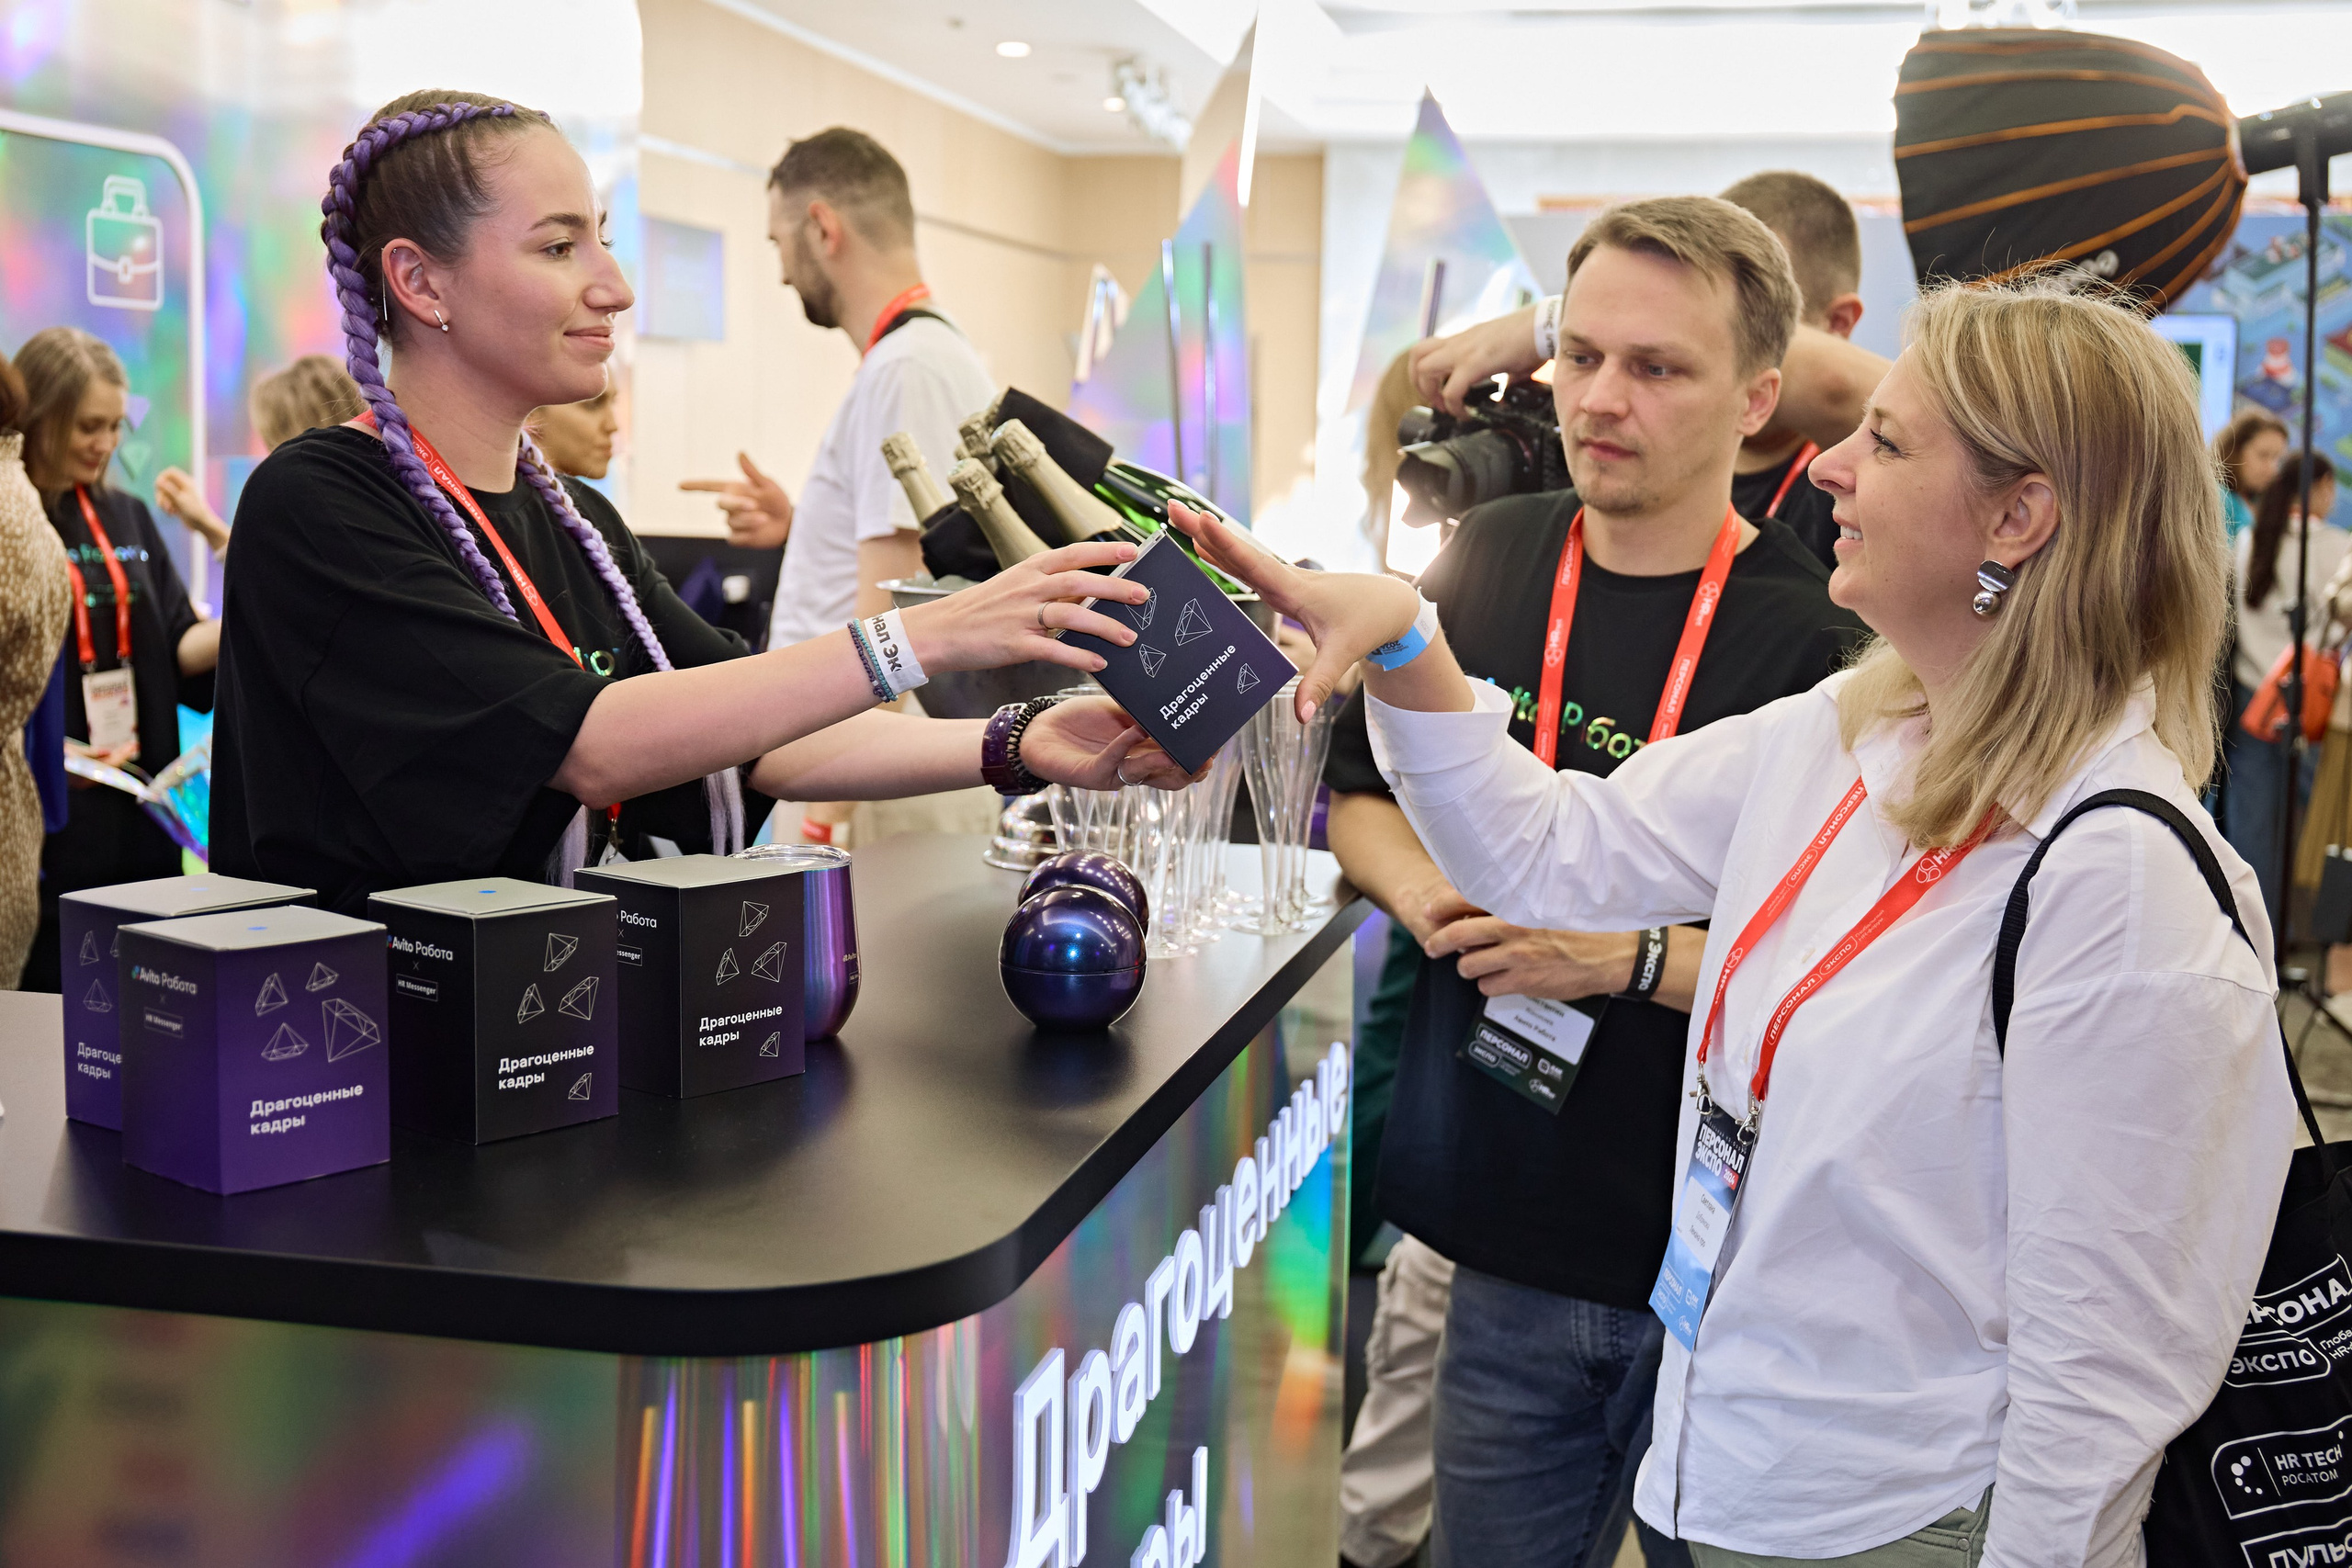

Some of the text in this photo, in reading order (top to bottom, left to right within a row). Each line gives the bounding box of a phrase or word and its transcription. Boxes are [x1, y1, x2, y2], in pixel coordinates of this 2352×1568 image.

[413, 440, 481, 521] ПЕРСОНАЛ ЭКС
[882, 643, 902, 672] Эк
[1159, 645, 1237, 720] Драгоценные
[1667, 659, 1690, 715] ПЕРСОНАЛ
[1170, 693, 1209, 729] кадры
[1791, 786, 1865, 881] ПЕРСОНАЛ ЭКСПО
[620, 909, 657, 929] Работа
[391, 936, 454, 962] Avito Работа
[616, 949, 641, 961] ssenger
[161, 972, 198, 995] Работа
[406, 980, 436, 996] Messenger
[1770, 943, 1852, 1040] ПЕРСОНАЛ ЭКСПО
[699, 1006, 783, 1032] Драгоценные
[699, 1031, 740, 1046] кадры
[1479, 1029, 1529, 1063] ПЕРСОНАЛ
[77, 1042, 122, 1065] Драгоце
[498, 1044, 594, 1074] Драгоценные
[77, 1062, 111, 1079] кадры
[498, 1072, 545, 1089] кадры
[250, 1084, 364, 1119] Драгоценные
[250, 1114, 306, 1135] кадры
[1695, 1141, 1723, 1177] ЭКСПО
[1699, 1122, 1746, 1174] ПЕРСОНАЛ
[1003, 1041, 1349, 1568] Драгоценные
[2319, 1329, 2352, 1350] Глоба
[2231, 1348, 2316, 1374] ЭКСПО
[2274, 1444, 2343, 1471] HR TECH
[2281, 1468, 2339, 1486] РОСАТОМ
